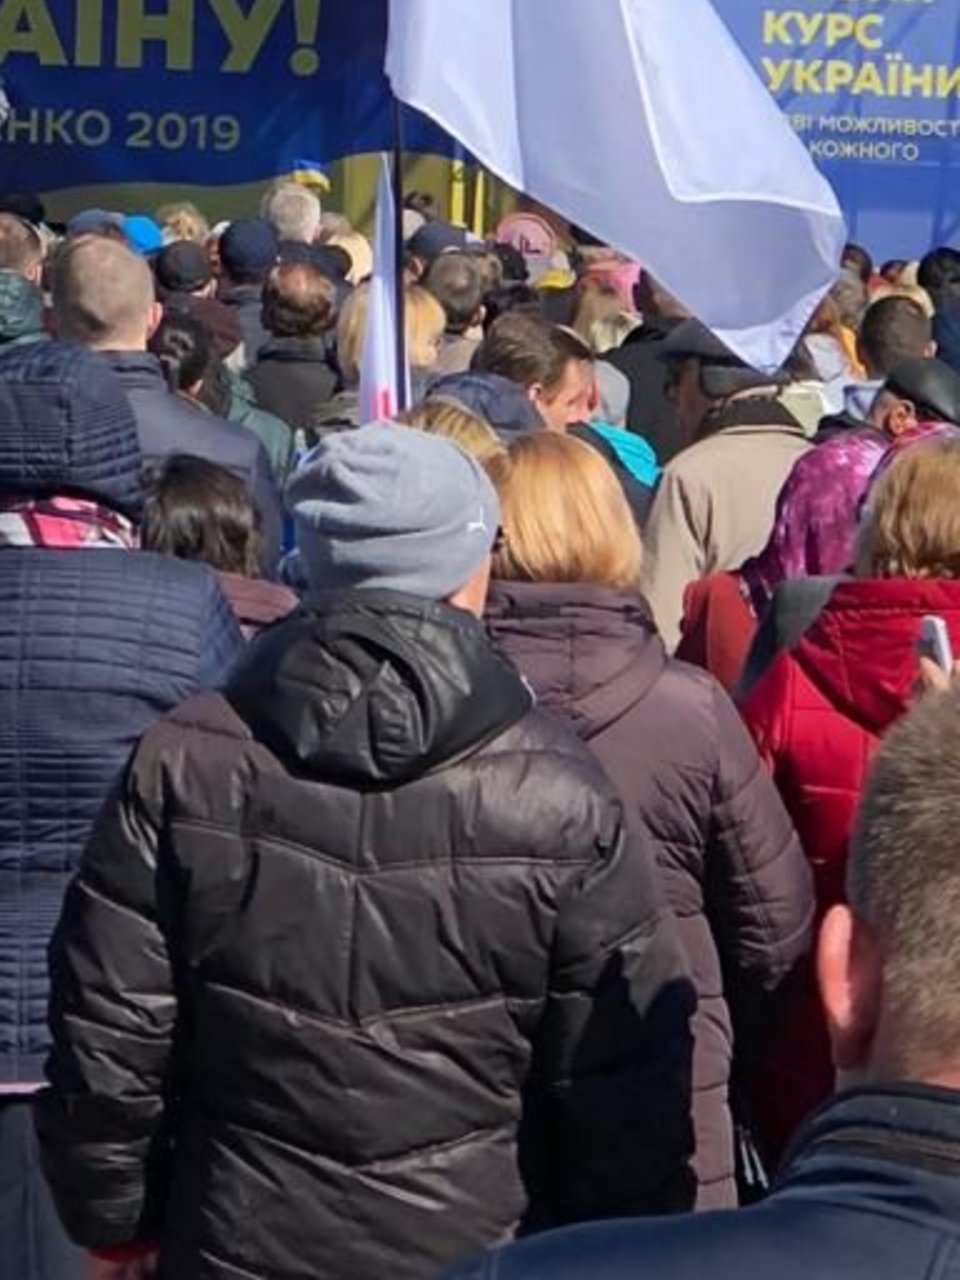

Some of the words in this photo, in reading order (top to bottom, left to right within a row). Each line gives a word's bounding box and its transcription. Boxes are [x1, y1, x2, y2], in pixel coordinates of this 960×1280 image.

[762, 10, 884, 50] КУРС
[125, 111, 241, 151] 2019
[808, 139, 920, 162] КОЖНОГО
